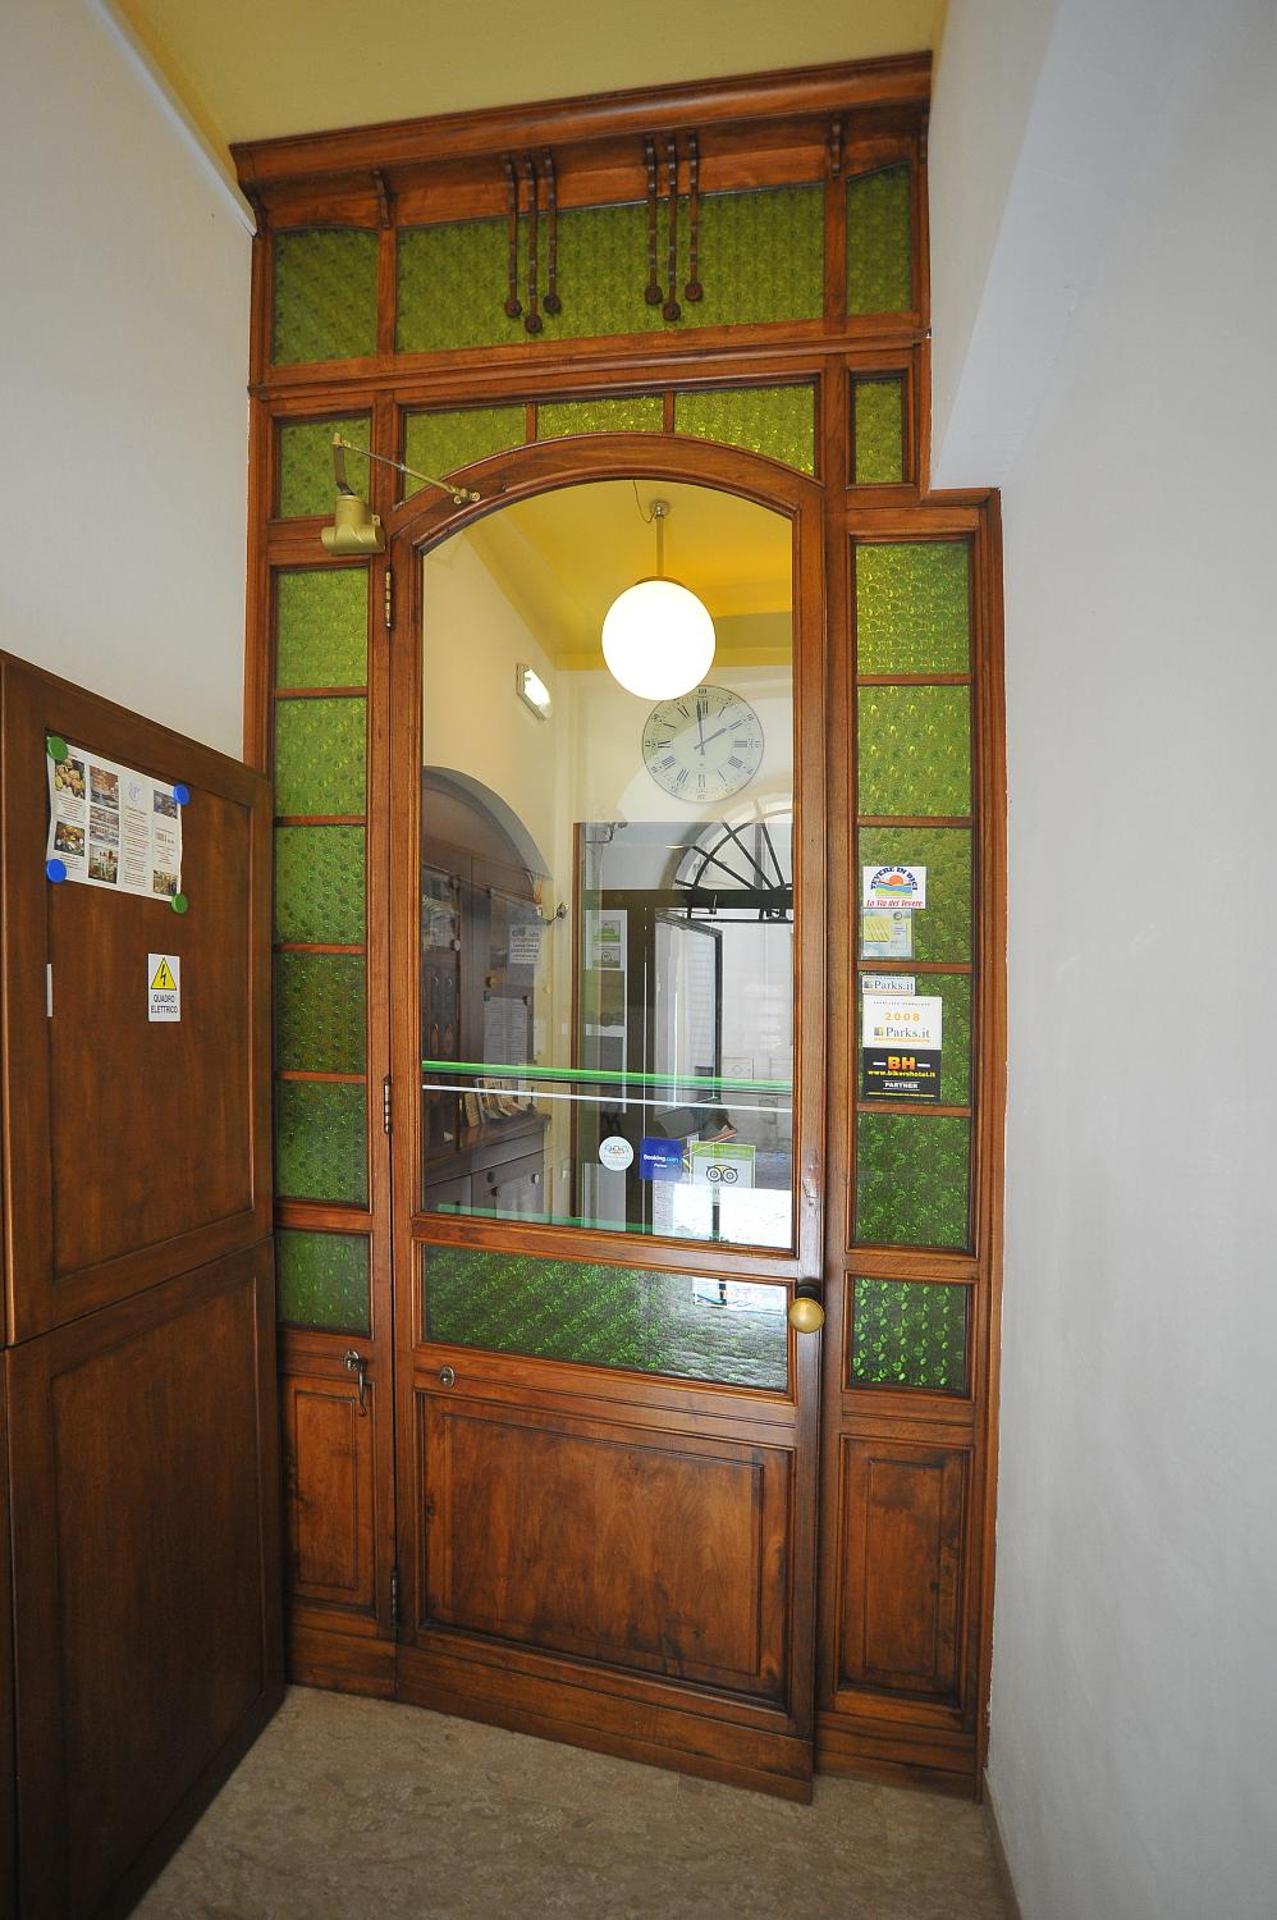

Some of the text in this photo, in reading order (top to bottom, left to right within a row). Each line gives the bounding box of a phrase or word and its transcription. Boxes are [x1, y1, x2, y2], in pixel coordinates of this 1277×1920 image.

[874, 980, 913, 990] Parks.it
[151, 1005, 178, 1014] ELETTRICO
[885, 1011, 920, 1022] 2008
[886, 1026, 930, 1038] Parks.it
[887, 1056, 916, 1070] BH
